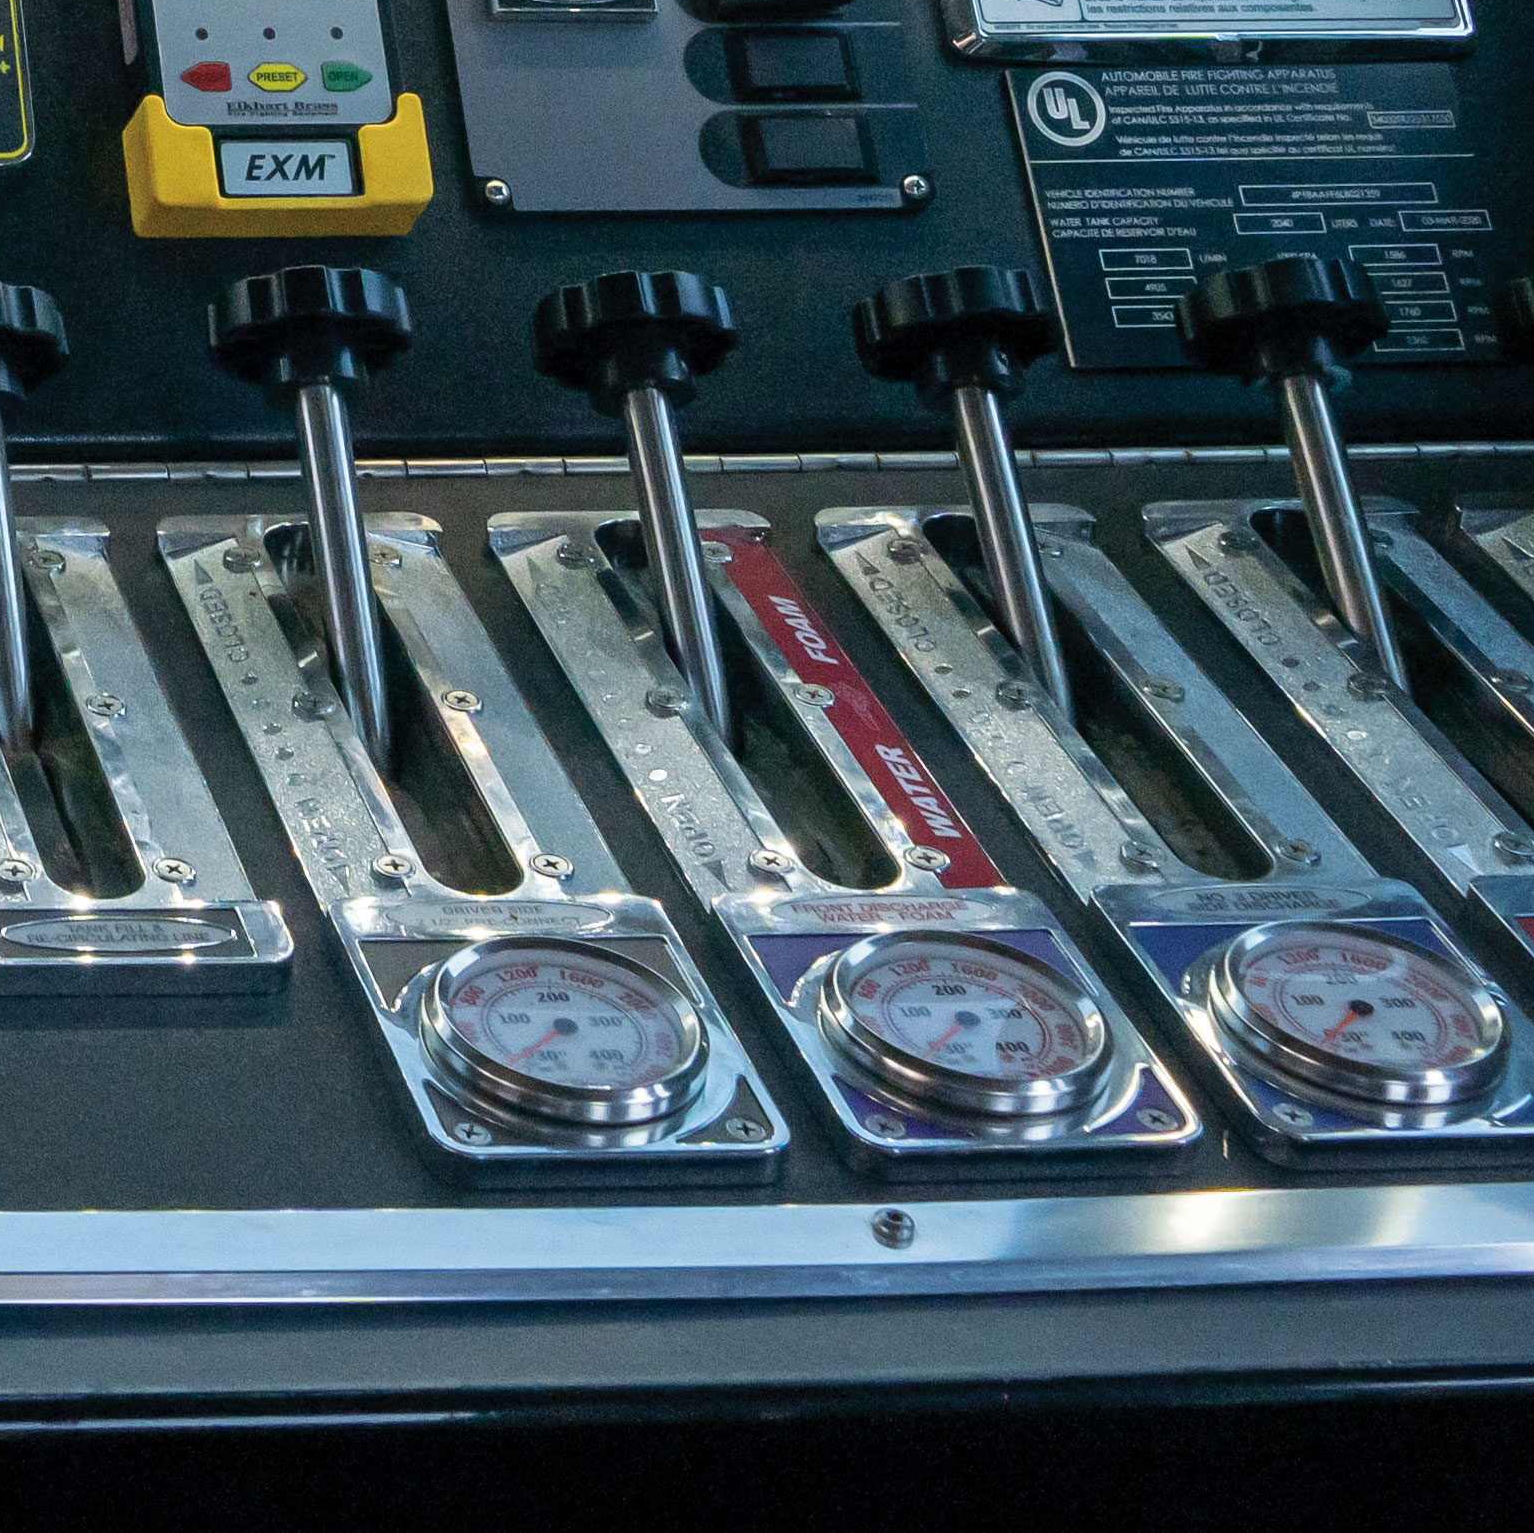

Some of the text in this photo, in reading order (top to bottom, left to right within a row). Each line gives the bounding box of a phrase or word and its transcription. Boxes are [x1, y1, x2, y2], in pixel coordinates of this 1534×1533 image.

[256, 72, 298, 83] PRESET
[328, 72, 359, 83] OPEN
[1101, 68, 1337, 82] AUTOMOBILE FIRE FIGHTING APPARATUS
[226, 101, 338, 111] Elkhart Brass
[1043, 87, 1090, 130] UL
[767, 594, 839, 665] FOAM
[875, 743, 962, 838] WATER
[790, 901, 968, 913] FRONT DISCHARGE
[818, 911, 955, 923] WATER FOAM
